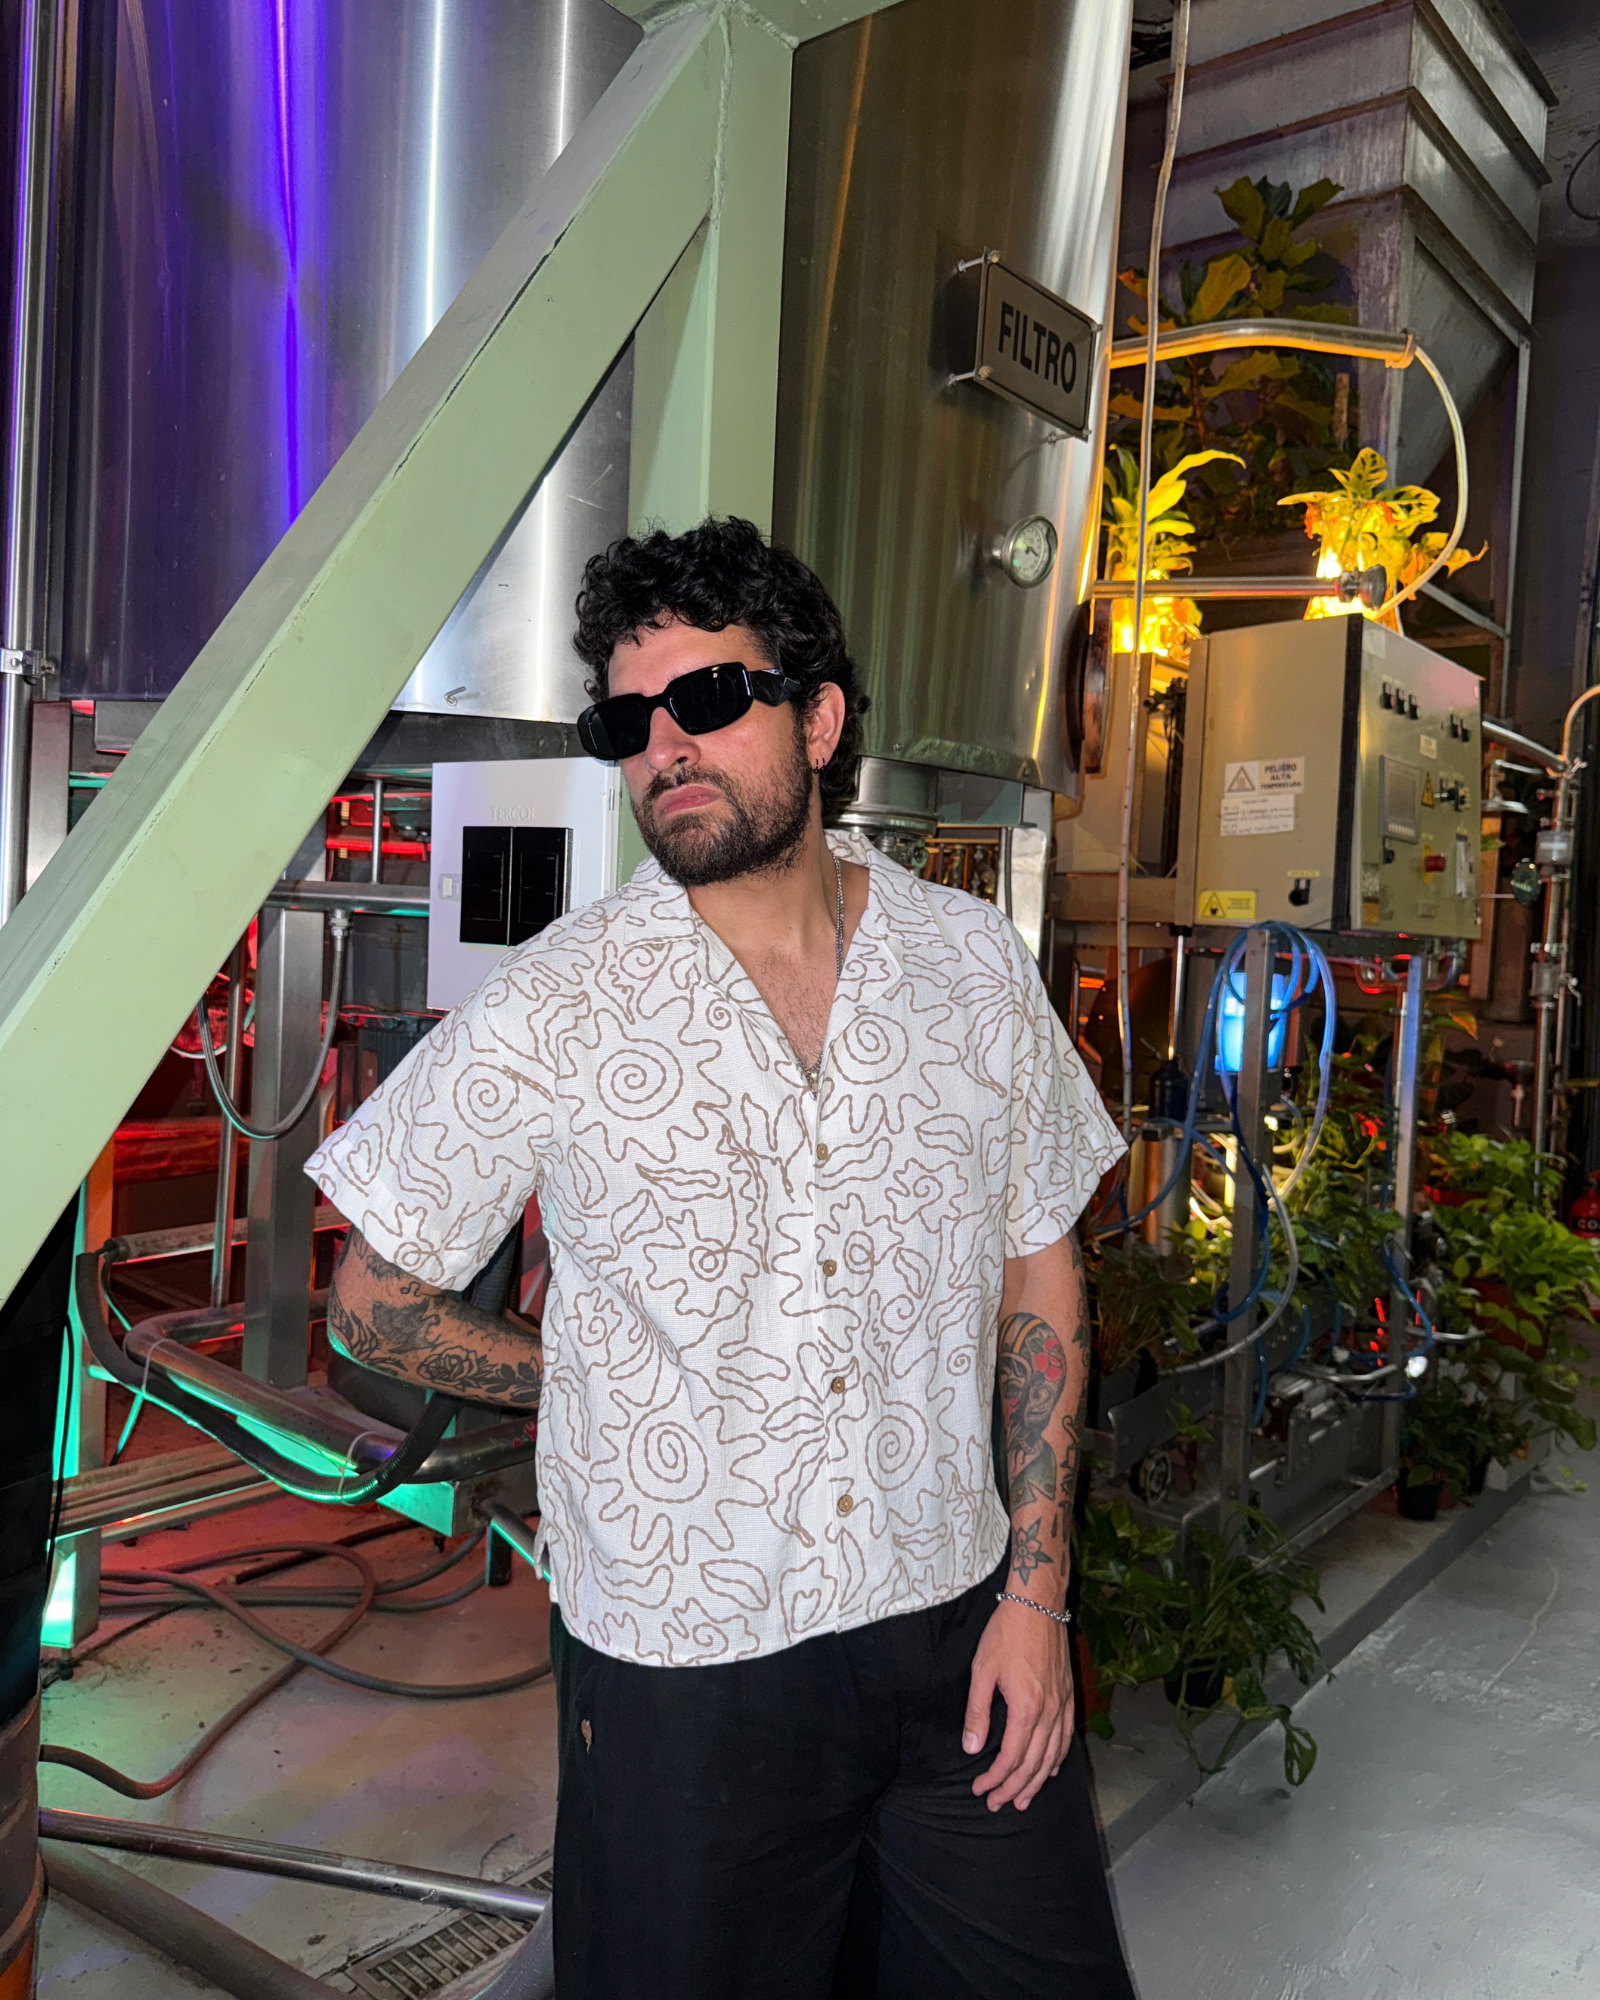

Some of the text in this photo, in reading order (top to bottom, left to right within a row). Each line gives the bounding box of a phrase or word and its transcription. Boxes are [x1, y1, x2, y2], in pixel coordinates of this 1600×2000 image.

[998, 301, 1077, 394] FILTRO
[1264, 763, 1297, 773] PELIGRO
[1260, 781, 1301, 790] TEMPERATURA
